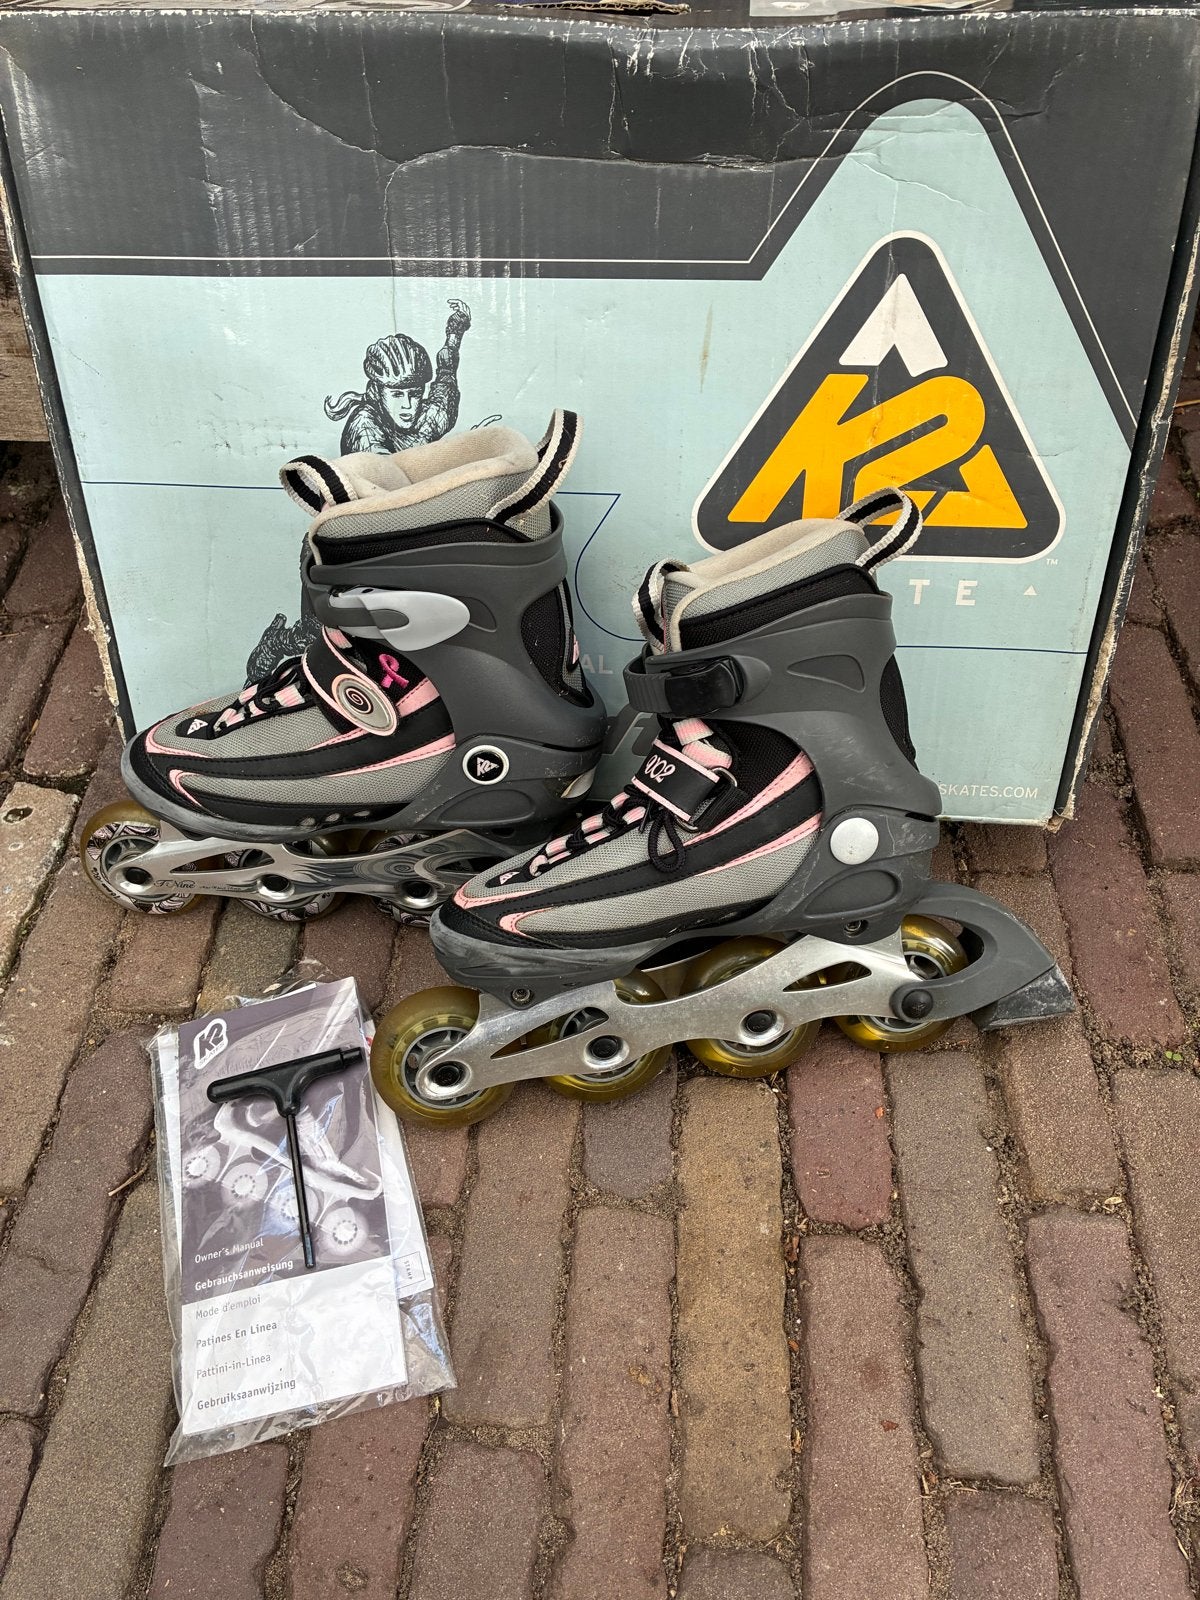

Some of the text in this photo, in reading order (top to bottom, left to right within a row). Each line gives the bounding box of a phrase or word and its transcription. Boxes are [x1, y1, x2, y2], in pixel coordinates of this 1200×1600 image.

[727, 373, 1028, 529] K2
[198, 1022, 225, 1061] K2
[232, 1238, 264, 1254] Manual
[194, 1259, 294, 1291] Gebrauchsanweisung
[195, 1294, 261, 1320] Mode d'emploi
[195, 1332, 232, 1349] Patines
[235, 1329, 247, 1339] En
[195, 1353, 271, 1380] Pattini-in-Linea
[197, 1379, 297, 1411] Gebruiksaanwijzing
